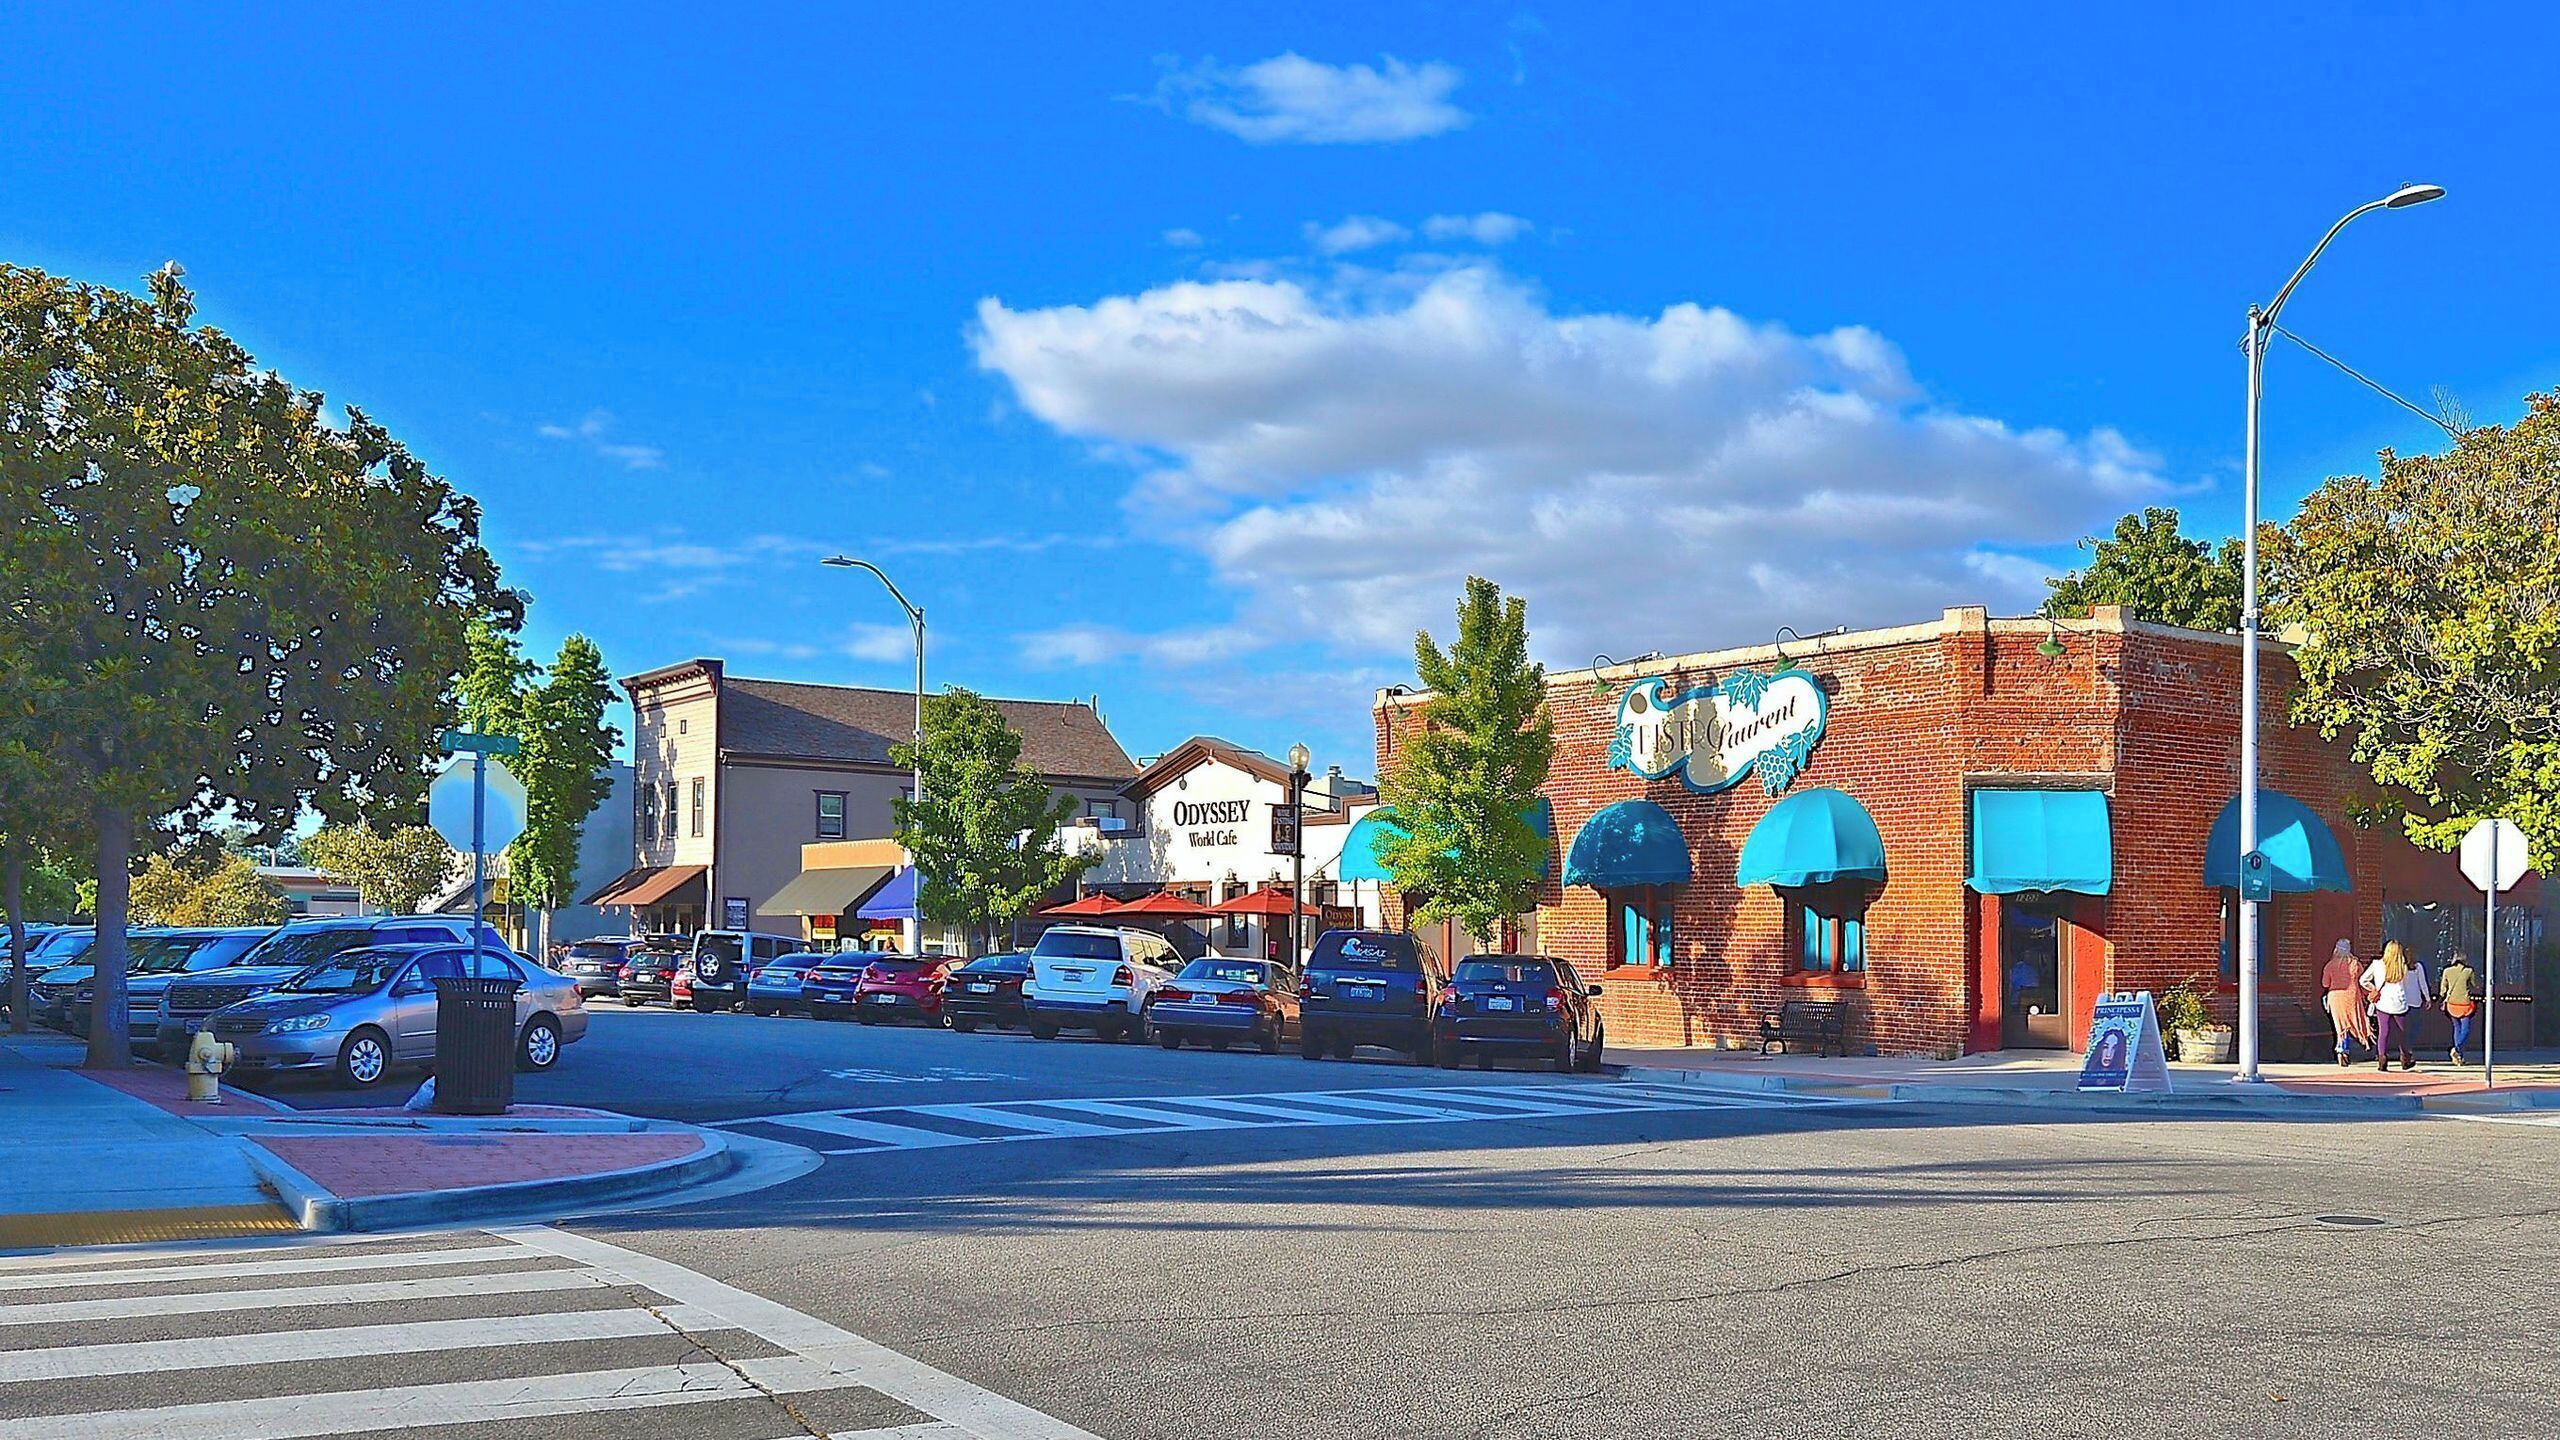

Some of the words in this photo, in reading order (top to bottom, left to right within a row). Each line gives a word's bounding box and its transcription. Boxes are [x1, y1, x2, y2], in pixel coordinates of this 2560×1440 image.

[1174, 800, 1250, 826] ODYSSEY
[1189, 831, 1215, 847] World
[1216, 829, 1237, 845] Cafe
